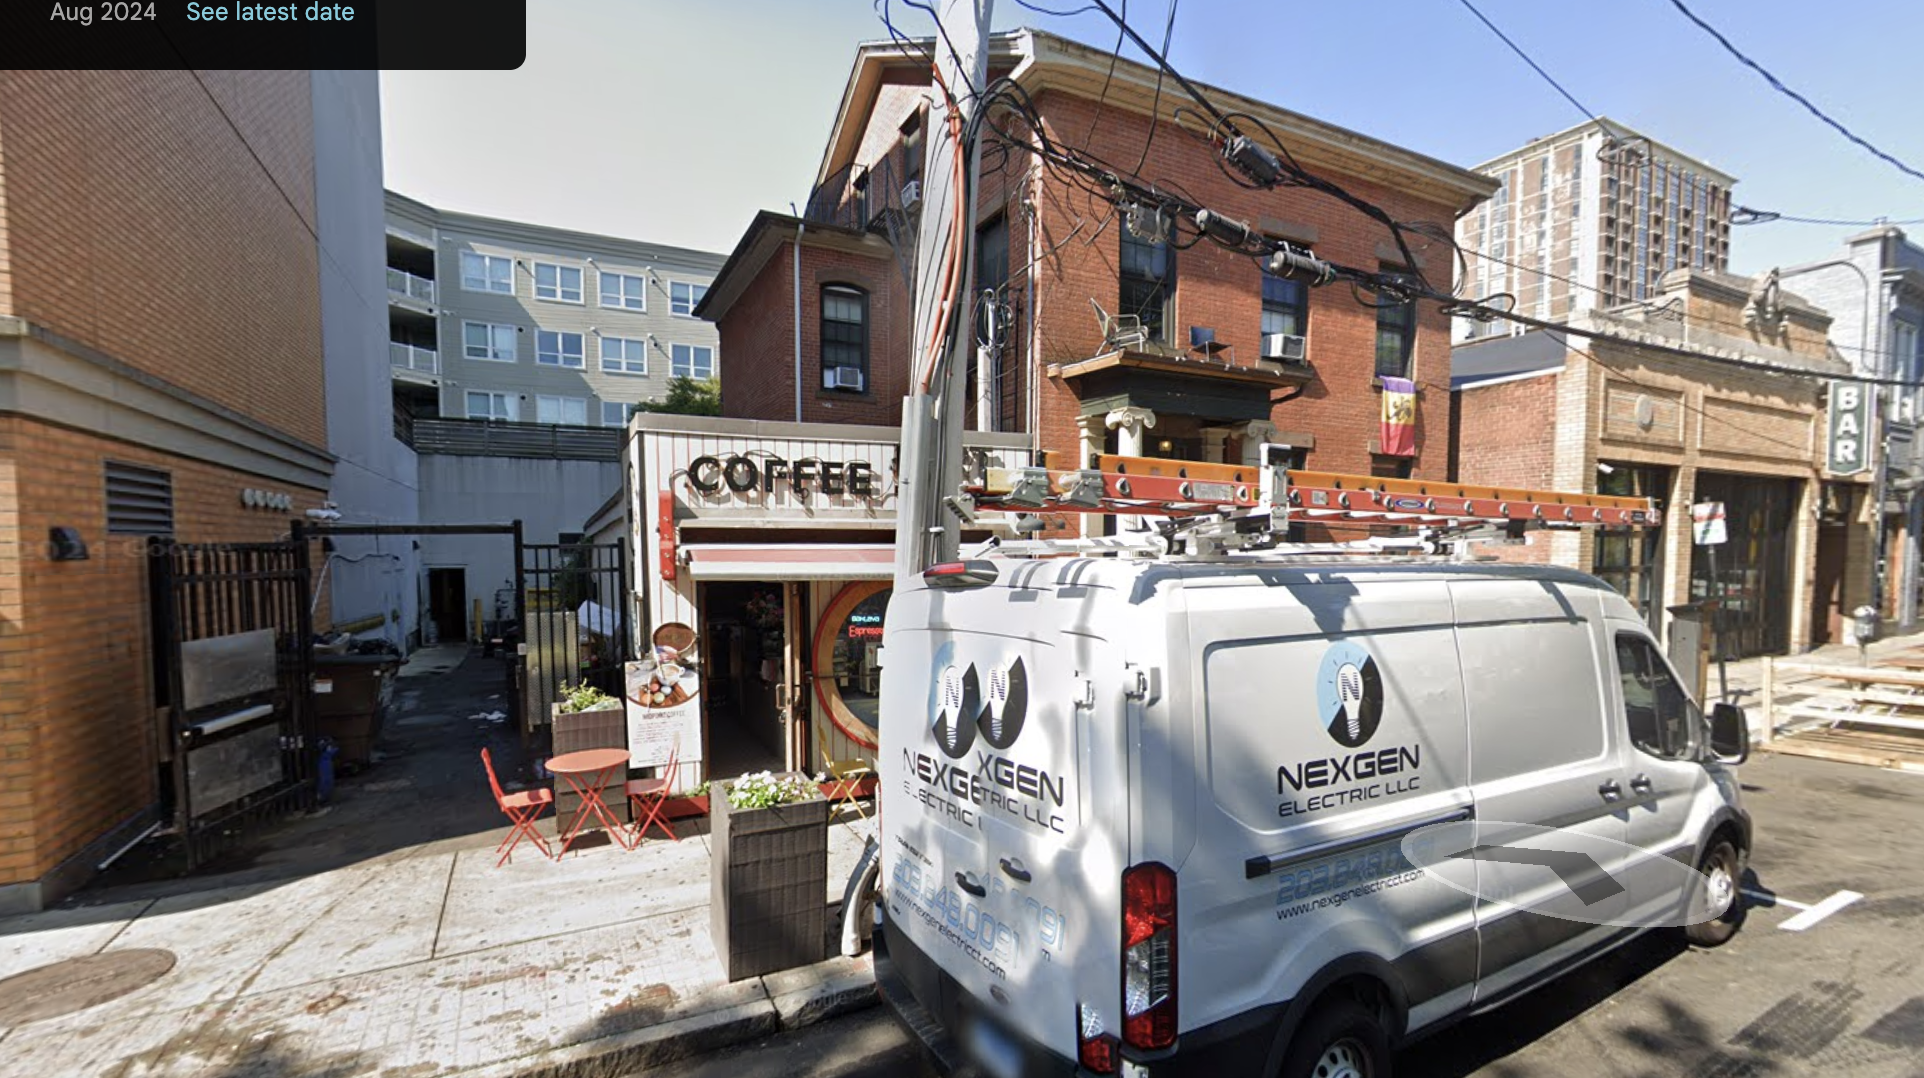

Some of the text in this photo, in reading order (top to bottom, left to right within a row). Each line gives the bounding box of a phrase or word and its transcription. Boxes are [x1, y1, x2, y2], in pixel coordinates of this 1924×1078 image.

[1836, 387, 1859, 463] BAR
[690, 456, 872, 495] COFFEE
[1277, 744, 1420, 795] NEXGEN
[1023, 804, 1065, 834] LLC
[1278, 776, 1421, 818] ELECTRIC LLC
[1276, 868, 1427, 920] www.nexgenelectricct.com
